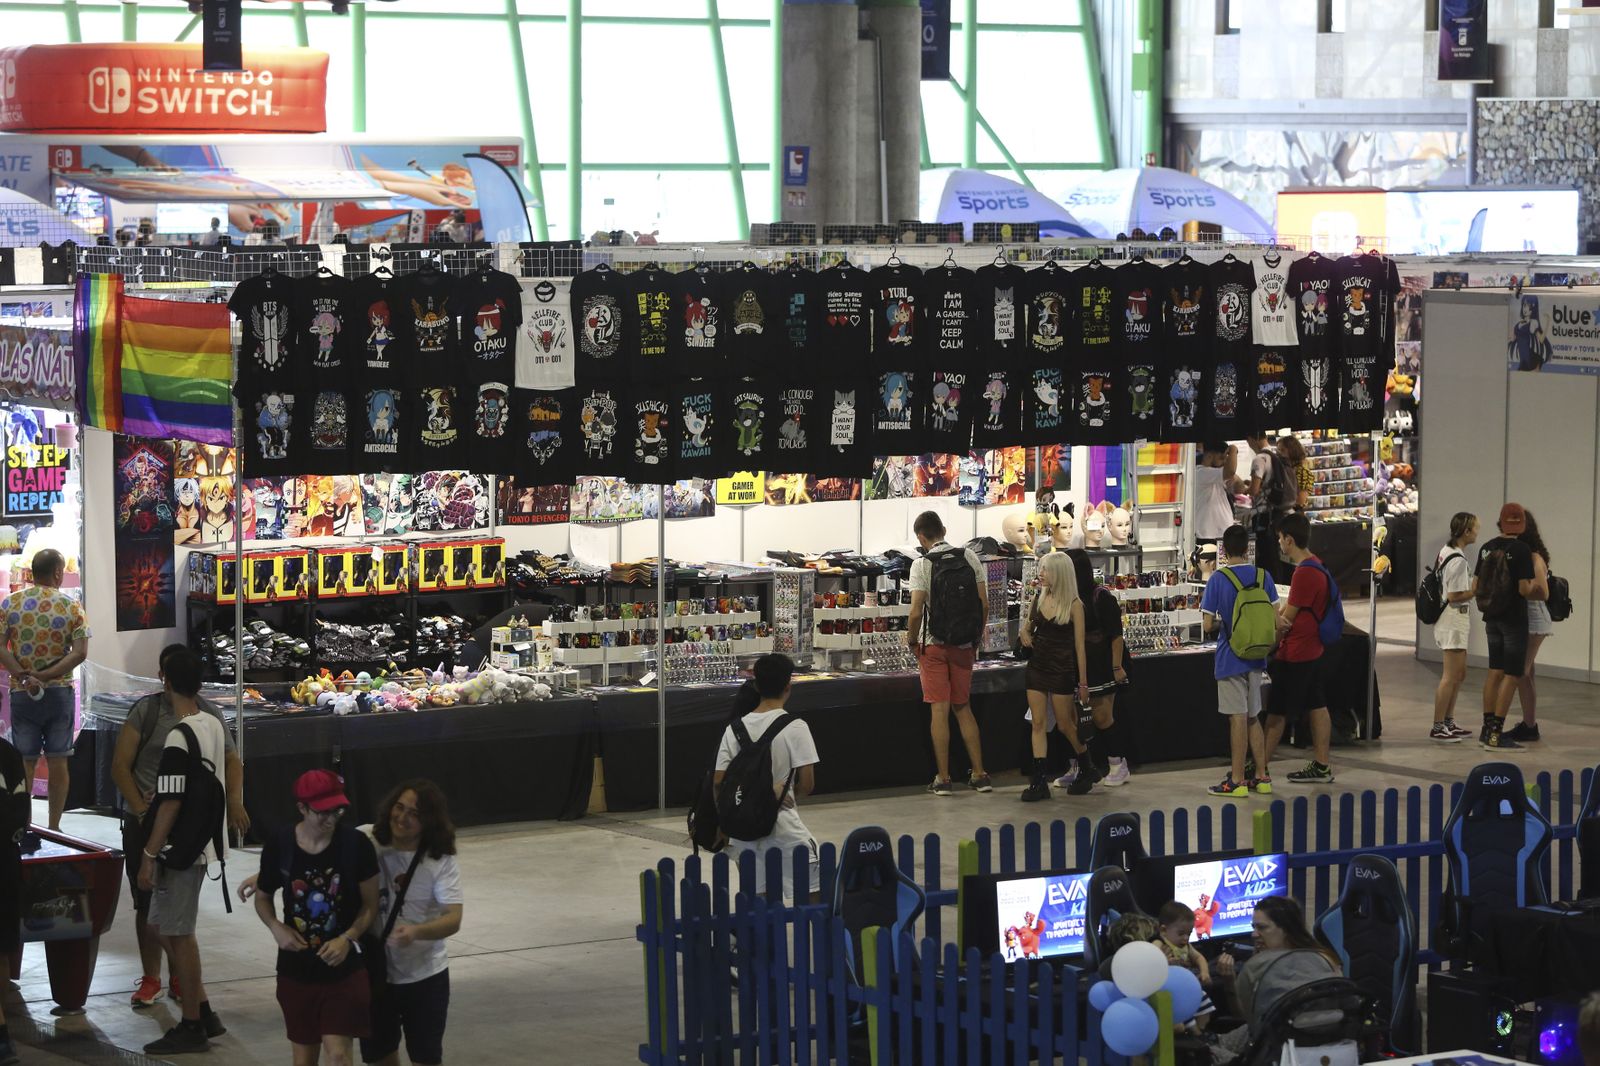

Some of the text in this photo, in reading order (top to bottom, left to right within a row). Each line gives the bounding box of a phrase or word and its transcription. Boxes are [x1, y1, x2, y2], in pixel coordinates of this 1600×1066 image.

[137, 68, 273, 87] NINTENDO
[137, 86, 273, 115] SWITCH
[958, 195, 1030, 214] Sports
[1151, 191, 1216, 211] Sports
[1260, 273, 1285, 285] HELLFIRE
[1266, 282, 1278, 290] CLUB
[888, 287, 908, 299] YURI
[263, 301, 277, 312] BTS
[944, 300, 962, 309] I AM
[532, 309, 561, 322] HELLFIRE
[1552, 304, 1591, 325] blue
[414, 315, 450, 329] KARASUNO
[539, 318, 554, 327] CLUB
[1125, 322, 1151, 333] OTAKU
[941, 328, 962, 338] KEEP
[474, 337, 508, 353] OTAKU
[939, 340, 964, 350] CALM
[367, 360, 390, 369] YANDERE
[943, 372, 966, 385] YAOI
[684, 393, 712, 407] FUCK
[695, 404, 711, 414] YOU
[878, 421, 911, 430] ANTISOCIAL
[364, 444, 397, 454] ANTISOCIAL
[681, 446, 711, 458] KAWAII
[8, 467, 66, 492] GAME
[732, 481, 754, 491] GAMER
[728, 490, 757, 500] AT WORK
[508, 516, 530, 524] TOKYO
[532, 514, 568, 523] REVENGERS
[1482, 775, 1511, 785] EVAD
[1110, 825, 1133, 837] EVAD
[859, 841, 884, 853] EVAD
[1223, 860, 1278, 888] EVAD
[1355, 867, 1380, 880] EVAD
[1103, 879, 1123, 893] EVAD
[1244, 878, 1277, 897] KIDS
